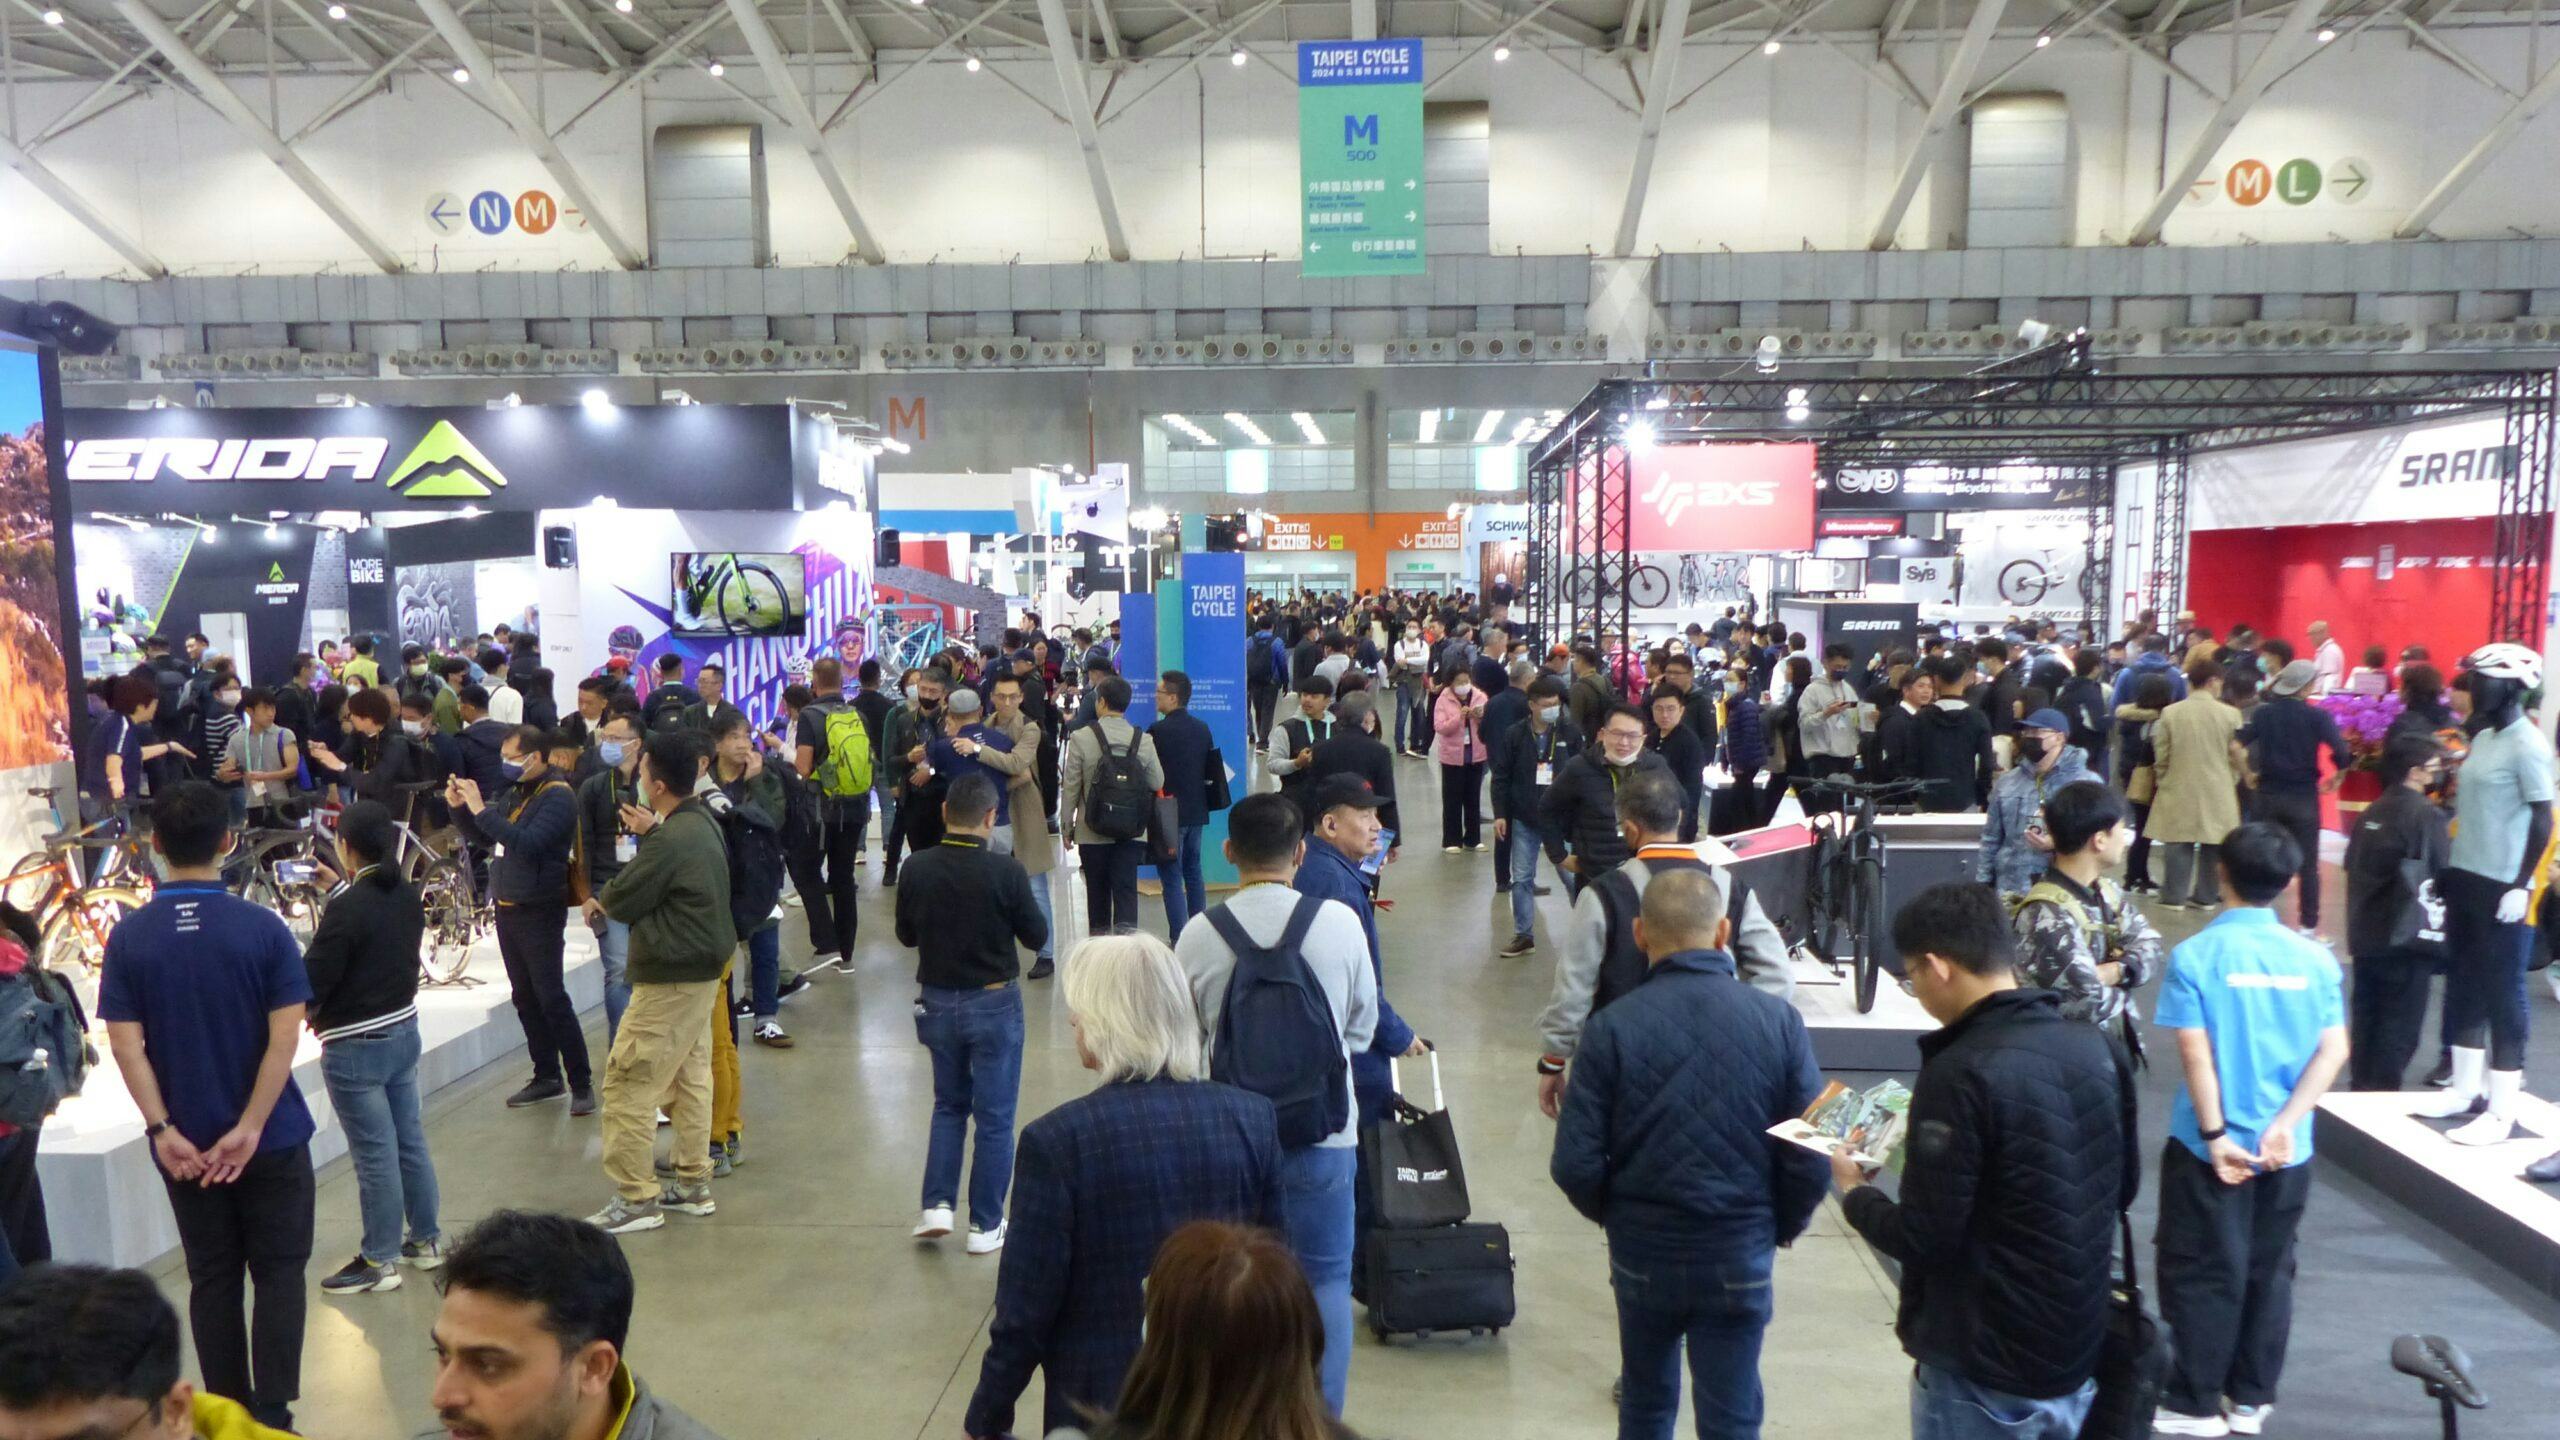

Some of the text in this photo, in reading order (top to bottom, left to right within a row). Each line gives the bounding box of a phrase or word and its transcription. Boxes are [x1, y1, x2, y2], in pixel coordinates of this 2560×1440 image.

[1312, 48, 1409, 66] TAIPEI CYCLE
[1312, 68, 1334, 78] 2024
[1344, 114, 1378, 146] M
[2234, 167, 2263, 198] M
[2288, 165, 2308, 198] L
[479, 198, 500, 228] N
[523, 197, 548, 228] M
[889, 397, 926, 440] M
[64, 438, 388, 480] ERIDA
[2399, 444, 2519, 488] SRAM
[1274, 523, 1299, 533] EXIT
[1422, 522, 1447, 532] EXIT
[351, 559, 383, 570] MORE
[351, 570, 384, 583] BIKE
[255, 583, 300, 594] MERIDA
[1191, 585, 1236, 600] TAIPEI
[1192, 602, 1236, 617] CYCLE
[1841, 620, 1901, 631] SRAM
